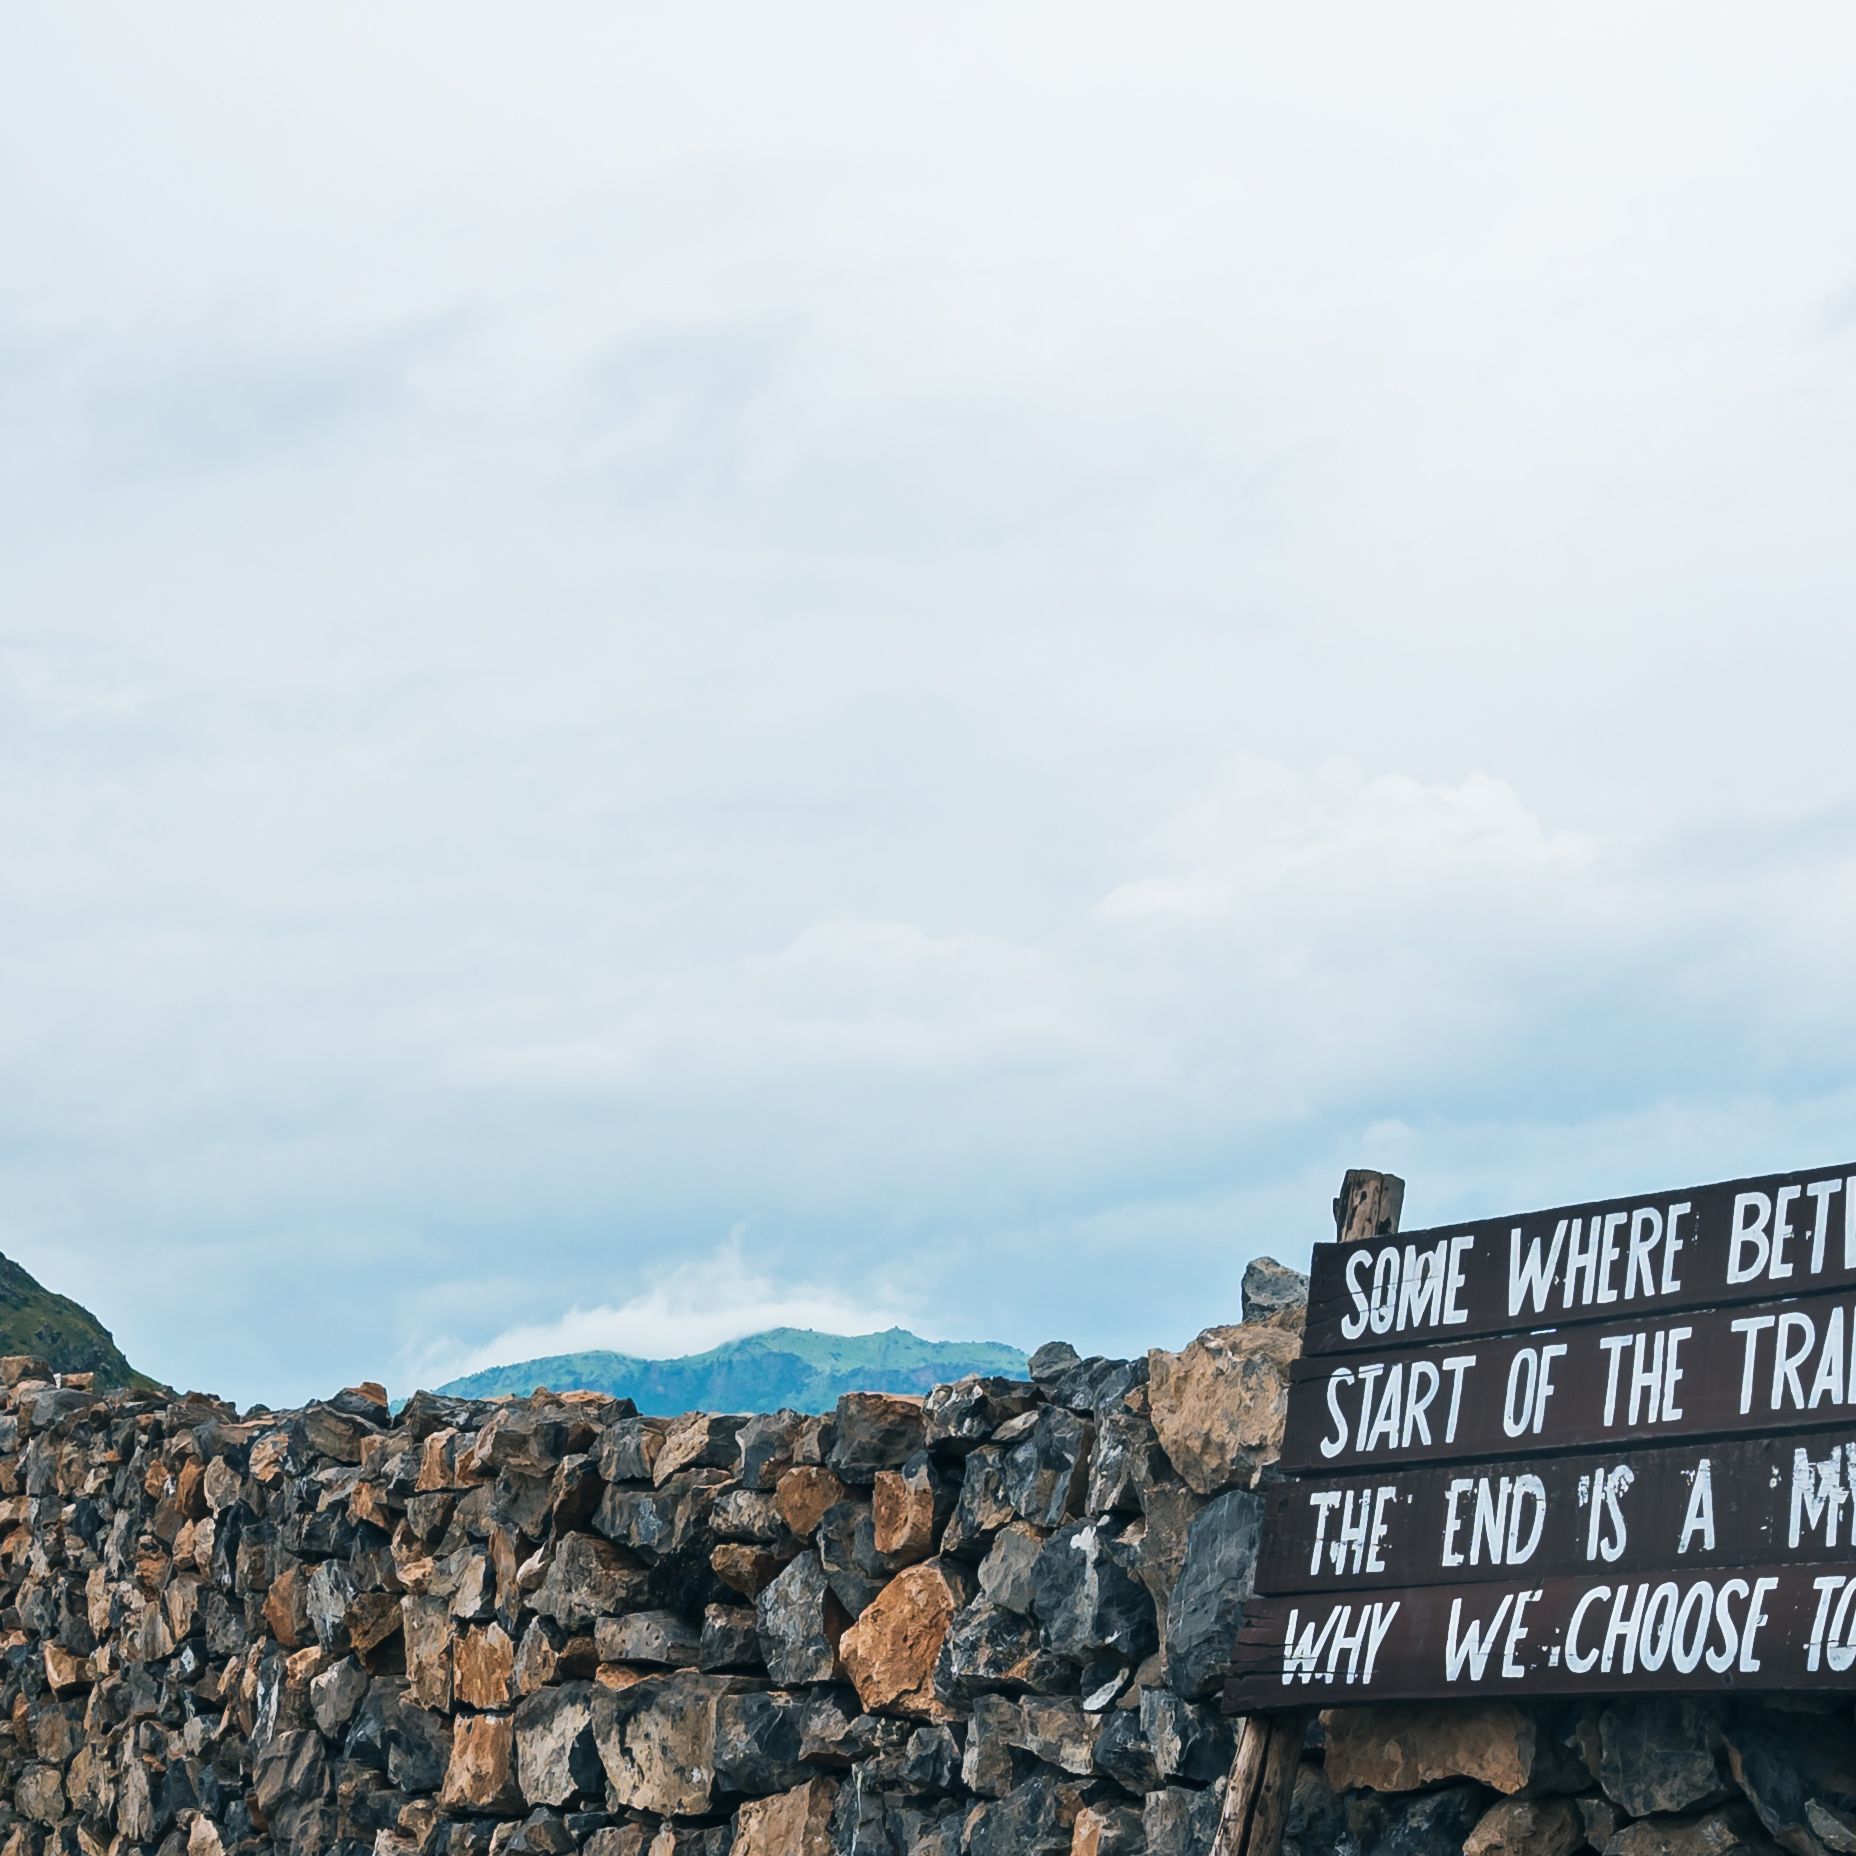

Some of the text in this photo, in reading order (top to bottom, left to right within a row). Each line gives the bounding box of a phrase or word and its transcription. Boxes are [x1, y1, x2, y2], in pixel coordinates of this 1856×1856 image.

[1342, 1233, 1474, 1339] SOME
[1505, 1200, 1692, 1316] WHERE
[1320, 1355, 1476, 1458] START
[1503, 1344, 1567, 1437] OF
[1600, 1327, 1692, 1426] THE
[1310, 1486, 1397, 1575] THE
[1442, 1474, 1546, 1566] END
[1587, 1465, 1634, 1562] IS
[1680, 1459, 1715, 1553] A
[1282, 1602, 1400, 1685] WHY
[1446, 1589, 1543, 1682] WE
[1565, 1577, 1779, 1674] CHOOSE
